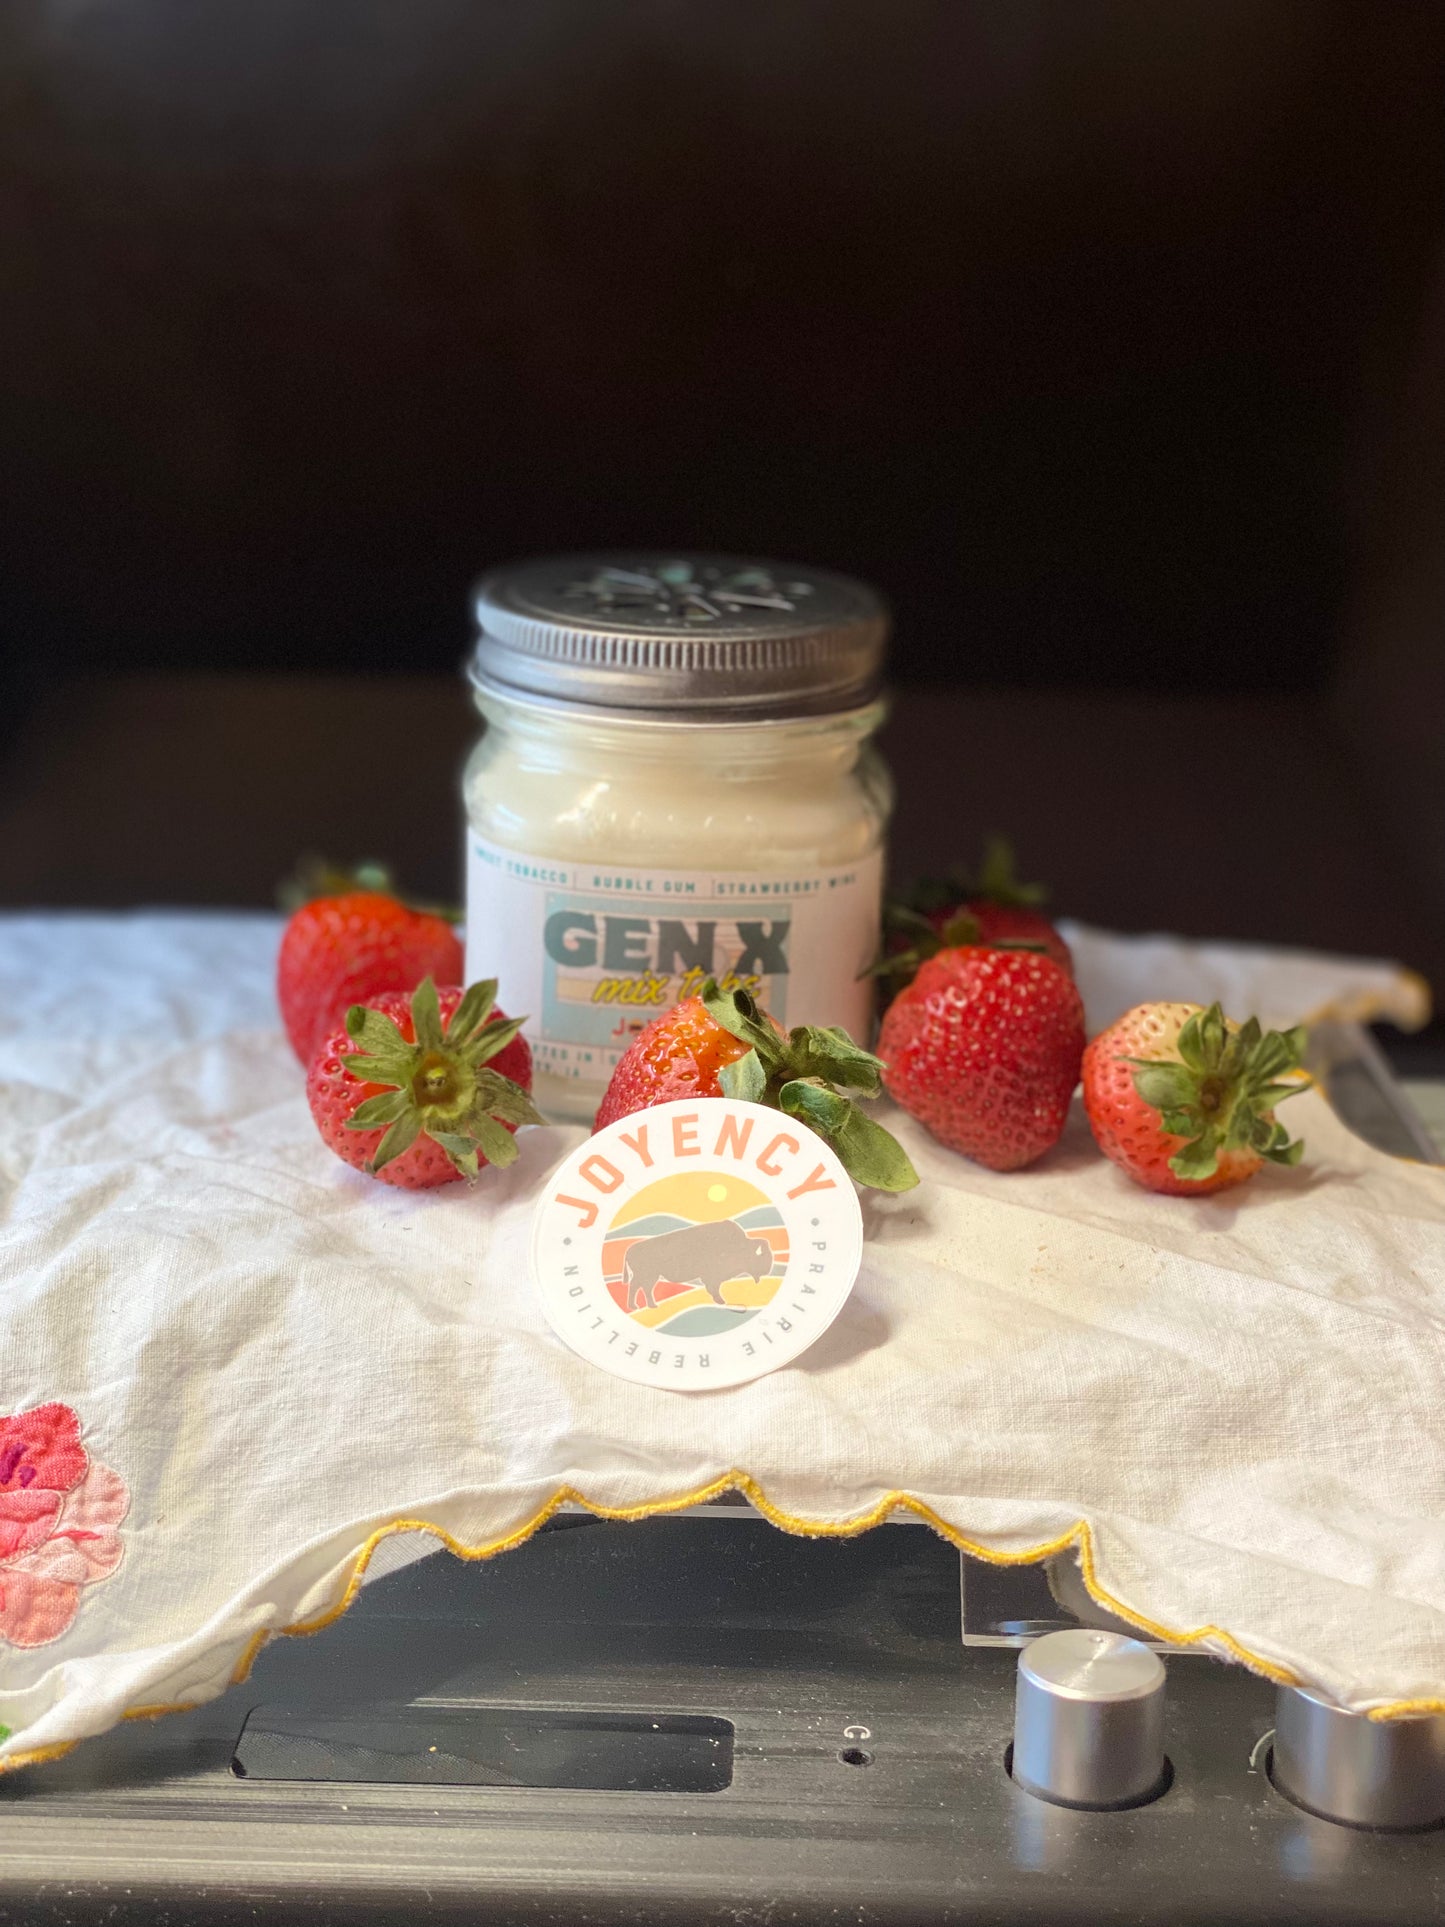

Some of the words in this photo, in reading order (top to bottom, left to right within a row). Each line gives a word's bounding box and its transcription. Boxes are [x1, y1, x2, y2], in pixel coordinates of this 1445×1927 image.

[506, 860, 568, 884] TOBACCO
[593, 876, 653, 892] BUBBLE
[663, 881, 696, 893] GUM
[717, 880, 820, 895] STRAWBERRY
[543, 909, 717, 975] GEN
[734, 920, 792, 975] X
[592, 969, 670, 1005] mix
[554, 1113, 837, 1229] JOYENCY
[563, 1264, 711, 1369] REBELLION
[741, 1240, 827, 1356] PRAIRIE
